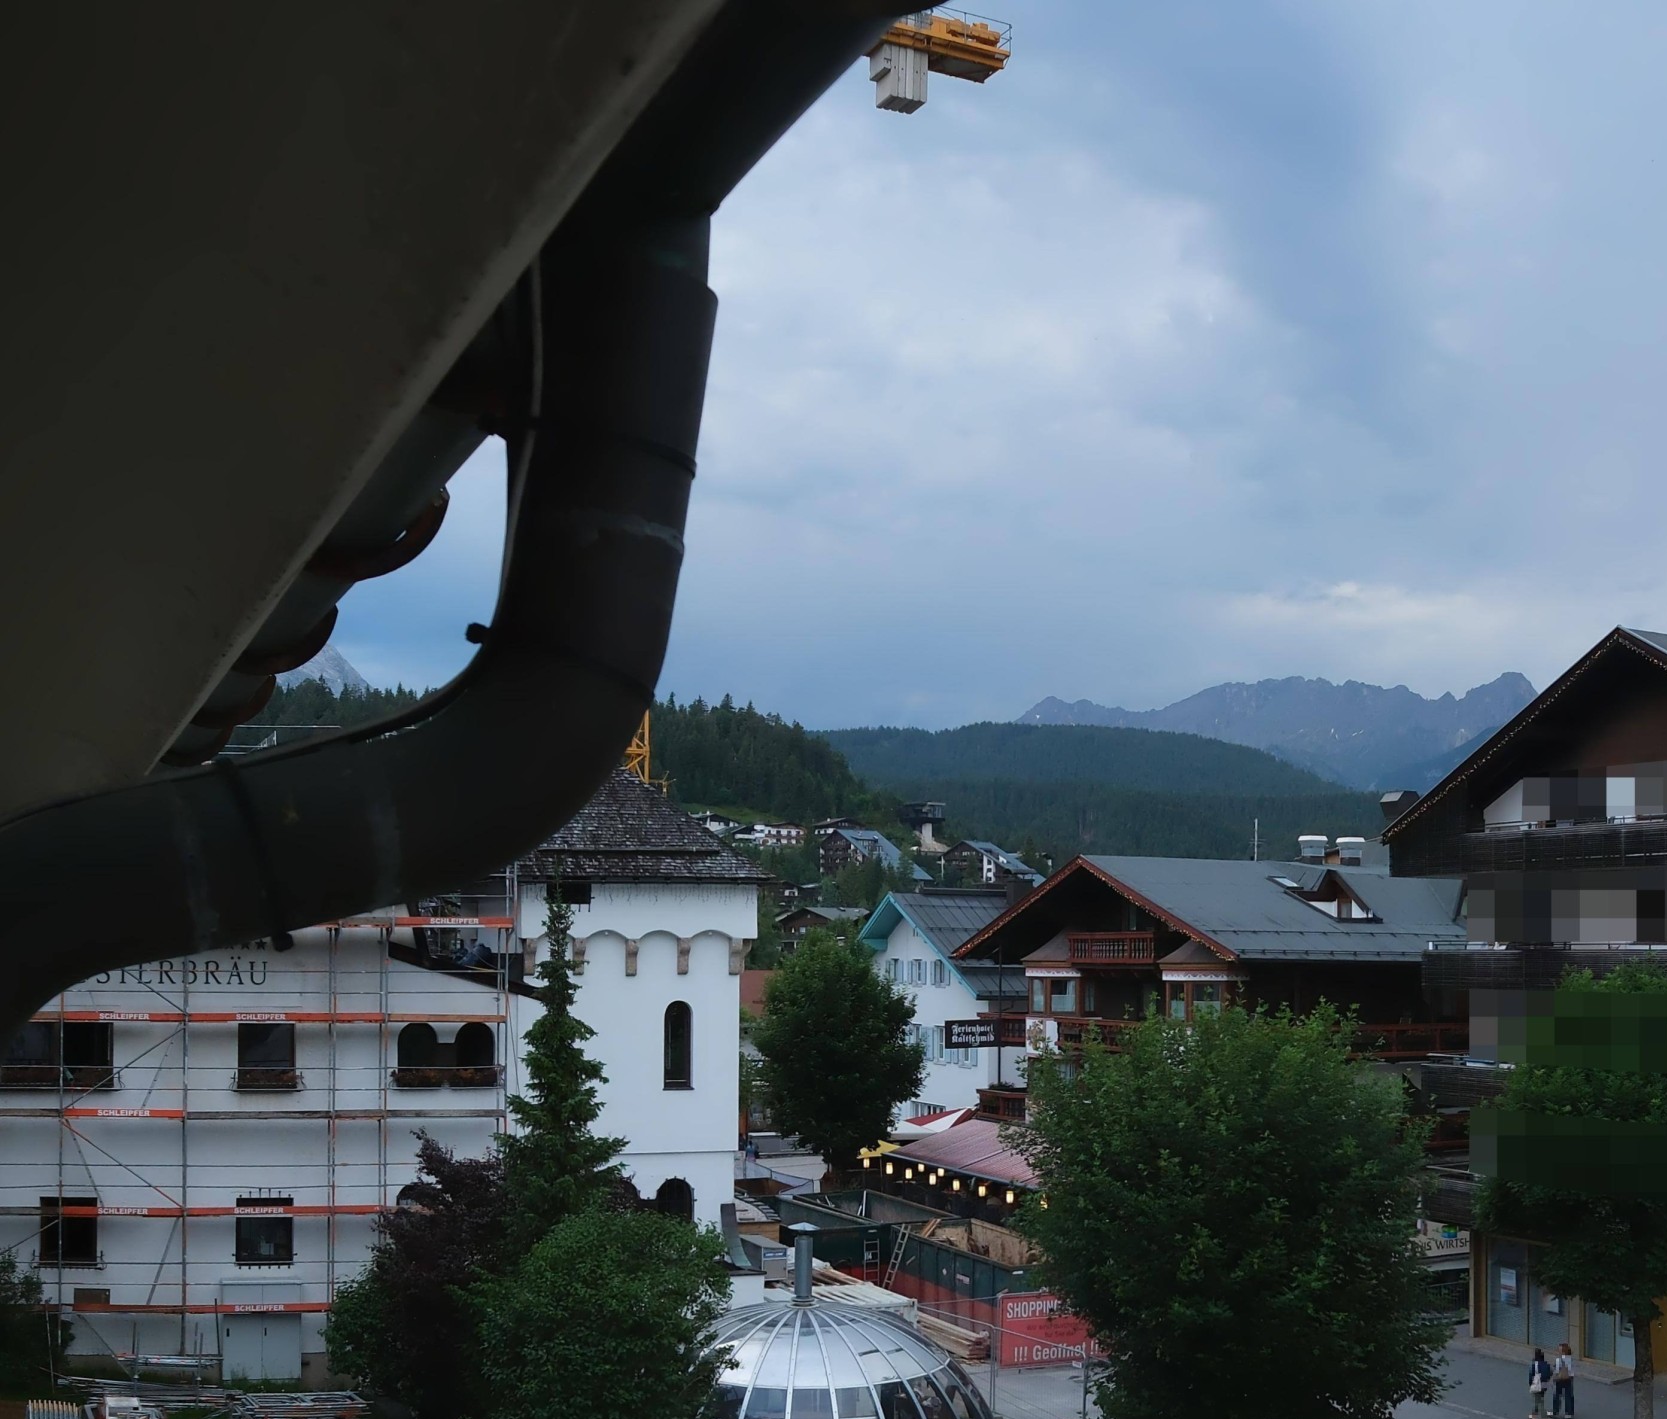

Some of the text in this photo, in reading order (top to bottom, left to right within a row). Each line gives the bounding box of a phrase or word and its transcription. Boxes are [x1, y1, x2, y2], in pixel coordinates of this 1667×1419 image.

[429, 917, 480, 925] SCHLEIPFER
[97, 1109, 151, 1117] SCHLEIPFER
[97, 1207, 148, 1215] SCHLEIPFER
